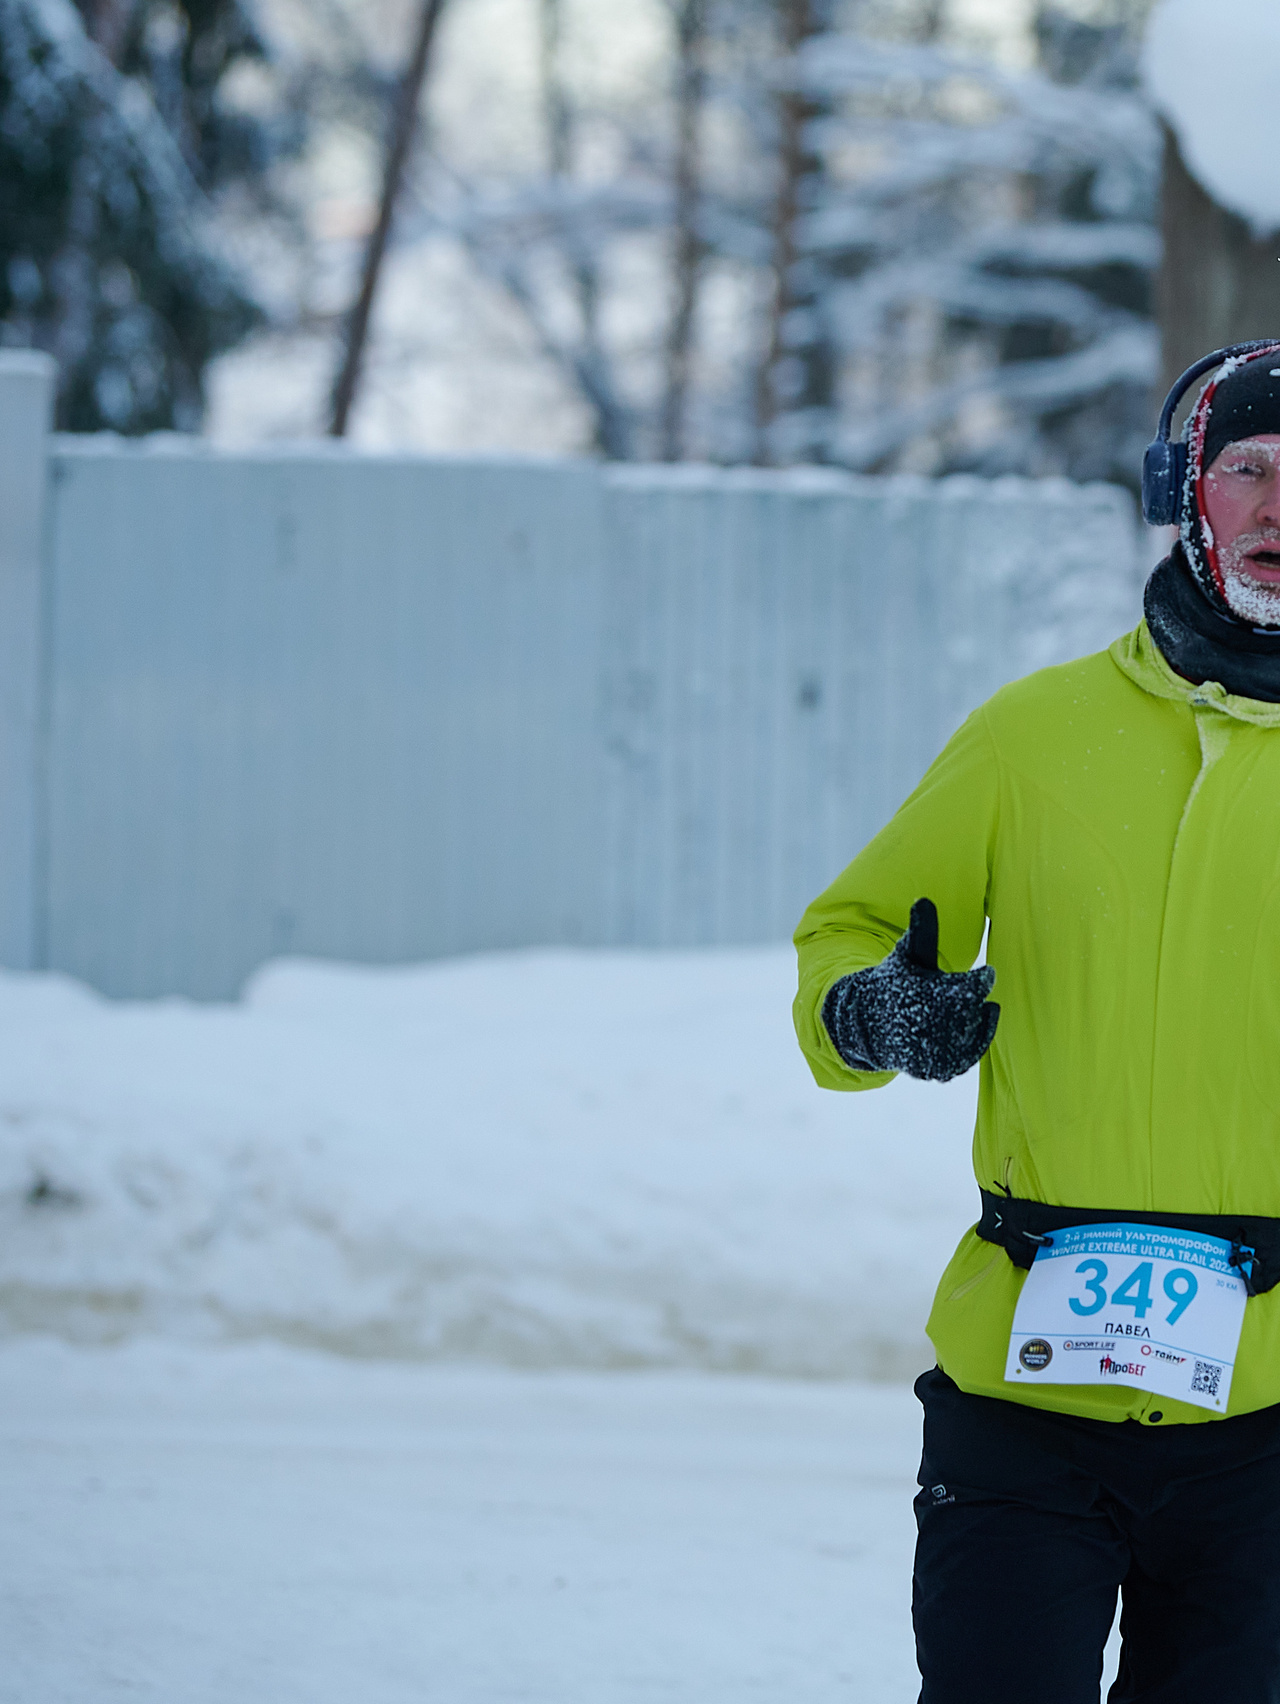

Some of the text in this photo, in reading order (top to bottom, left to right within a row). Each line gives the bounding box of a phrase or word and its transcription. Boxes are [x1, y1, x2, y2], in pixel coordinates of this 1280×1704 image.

[1083, 1229, 1122, 1240] зимний
[1125, 1231, 1226, 1256] ультрамарафон
[1088, 1242, 1137, 1254] EXTREME
[1140, 1245, 1175, 1259] ULTRA
[1178, 1250, 1207, 1266] TRAIL
[1068, 1258, 1198, 1326] 349
[1105, 1322, 1151, 1338] ПАВЕЛ
